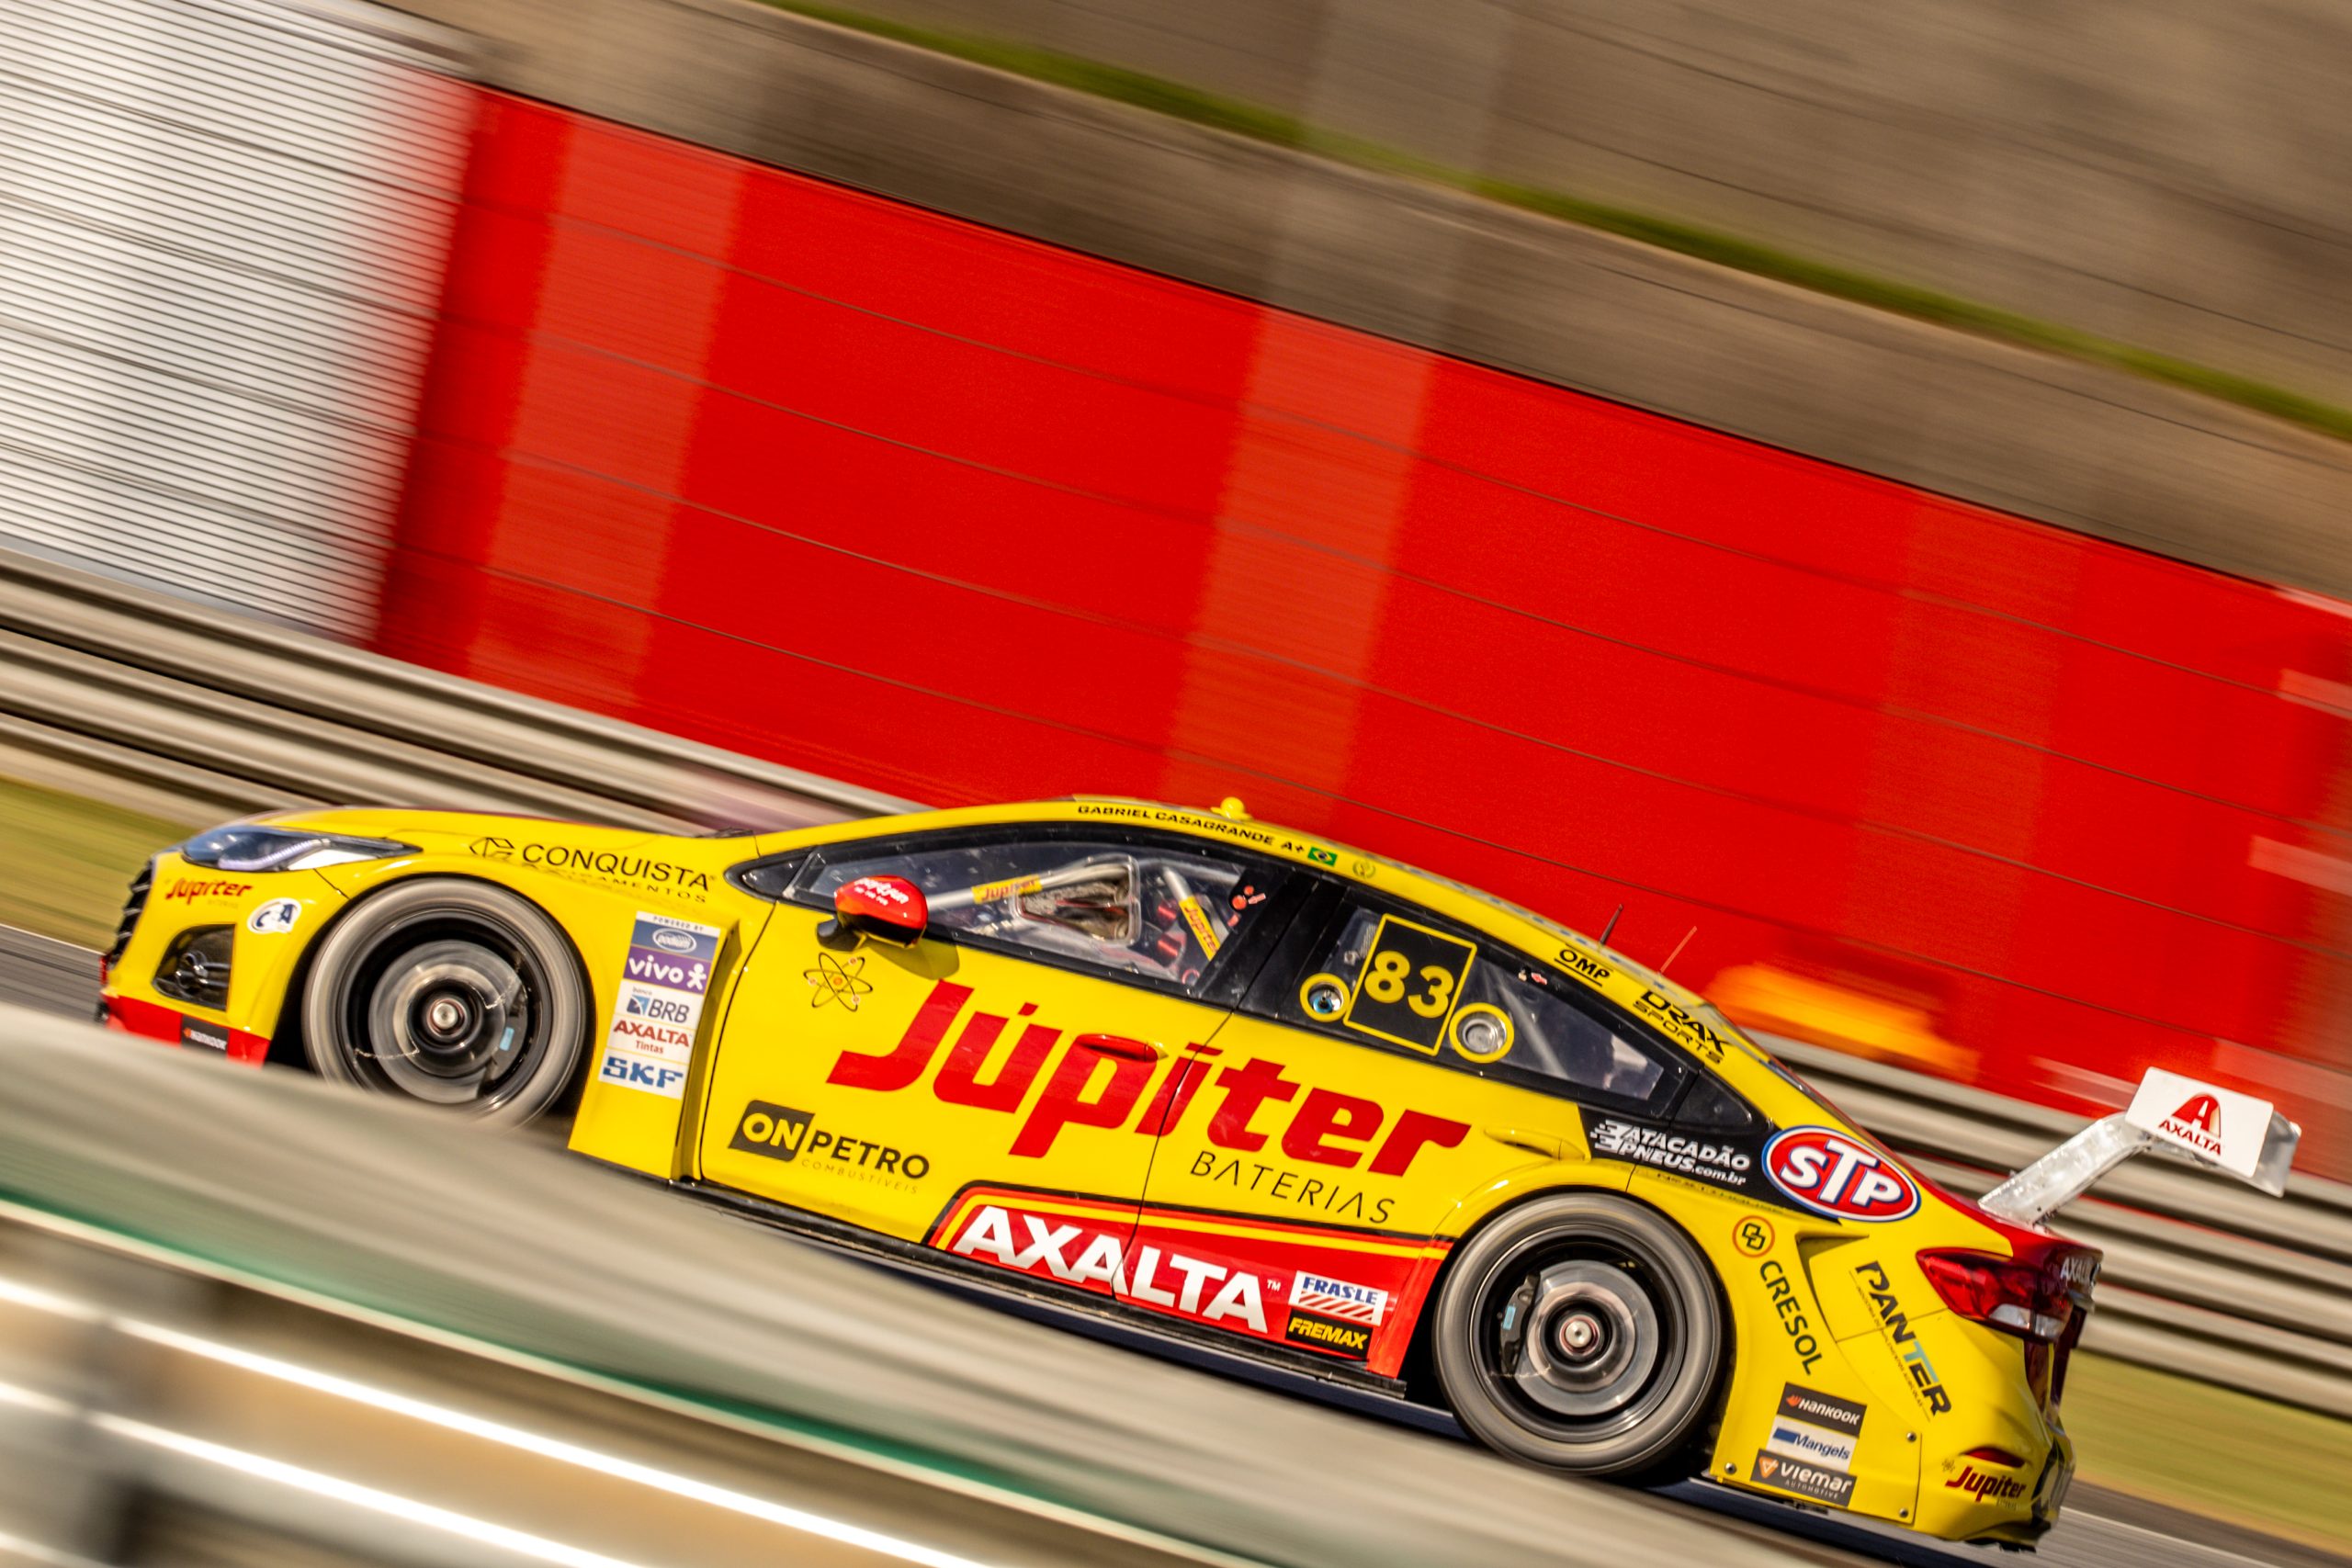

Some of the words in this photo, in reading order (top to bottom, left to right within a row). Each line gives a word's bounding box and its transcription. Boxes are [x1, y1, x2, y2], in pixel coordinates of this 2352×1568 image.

[1078, 805, 1150, 819] GABRIEL
[1156, 812, 1275, 846] CASAGRANDE
[522, 843, 709, 892] CONQUISTA
[628, 954, 684, 984] vivo
[1363, 950, 1455, 1019] 83
[1559, 949, 1611, 979] OMP
[648, 998, 691, 1024] BRB
[1640, 989, 1733, 1056] DRAX
[613, 1020, 690, 1047] AXALTA
[636, 1040, 664, 1054] Tintas
[1632, 999, 1724, 1065] SPORTS
[602, 1055, 684, 1089] SKF
[826, 979, 1472, 1178] Júpiter
[1622, 1126, 1751, 1171] ATACADÃO
[2158, 1118, 2221, 1156] AXALTA
[801, 1157, 919, 1194] COMBUSTÍVEIS
[1190, 1151, 1396, 1224] BATERIAS
[1779, 1137, 1904, 1208] STP
[954, 1204, 1269, 1334] AXALTA
[1288, 1316, 1368, 1350] FREMAX
[1759, 1260, 1823, 1375] CRESOL
[1855, 1260, 1952, 1416] PANTER
[1794, 1434, 1850, 1461] Mangels
[1784, 1479, 1838, 1500] AUTOMOTIVE
